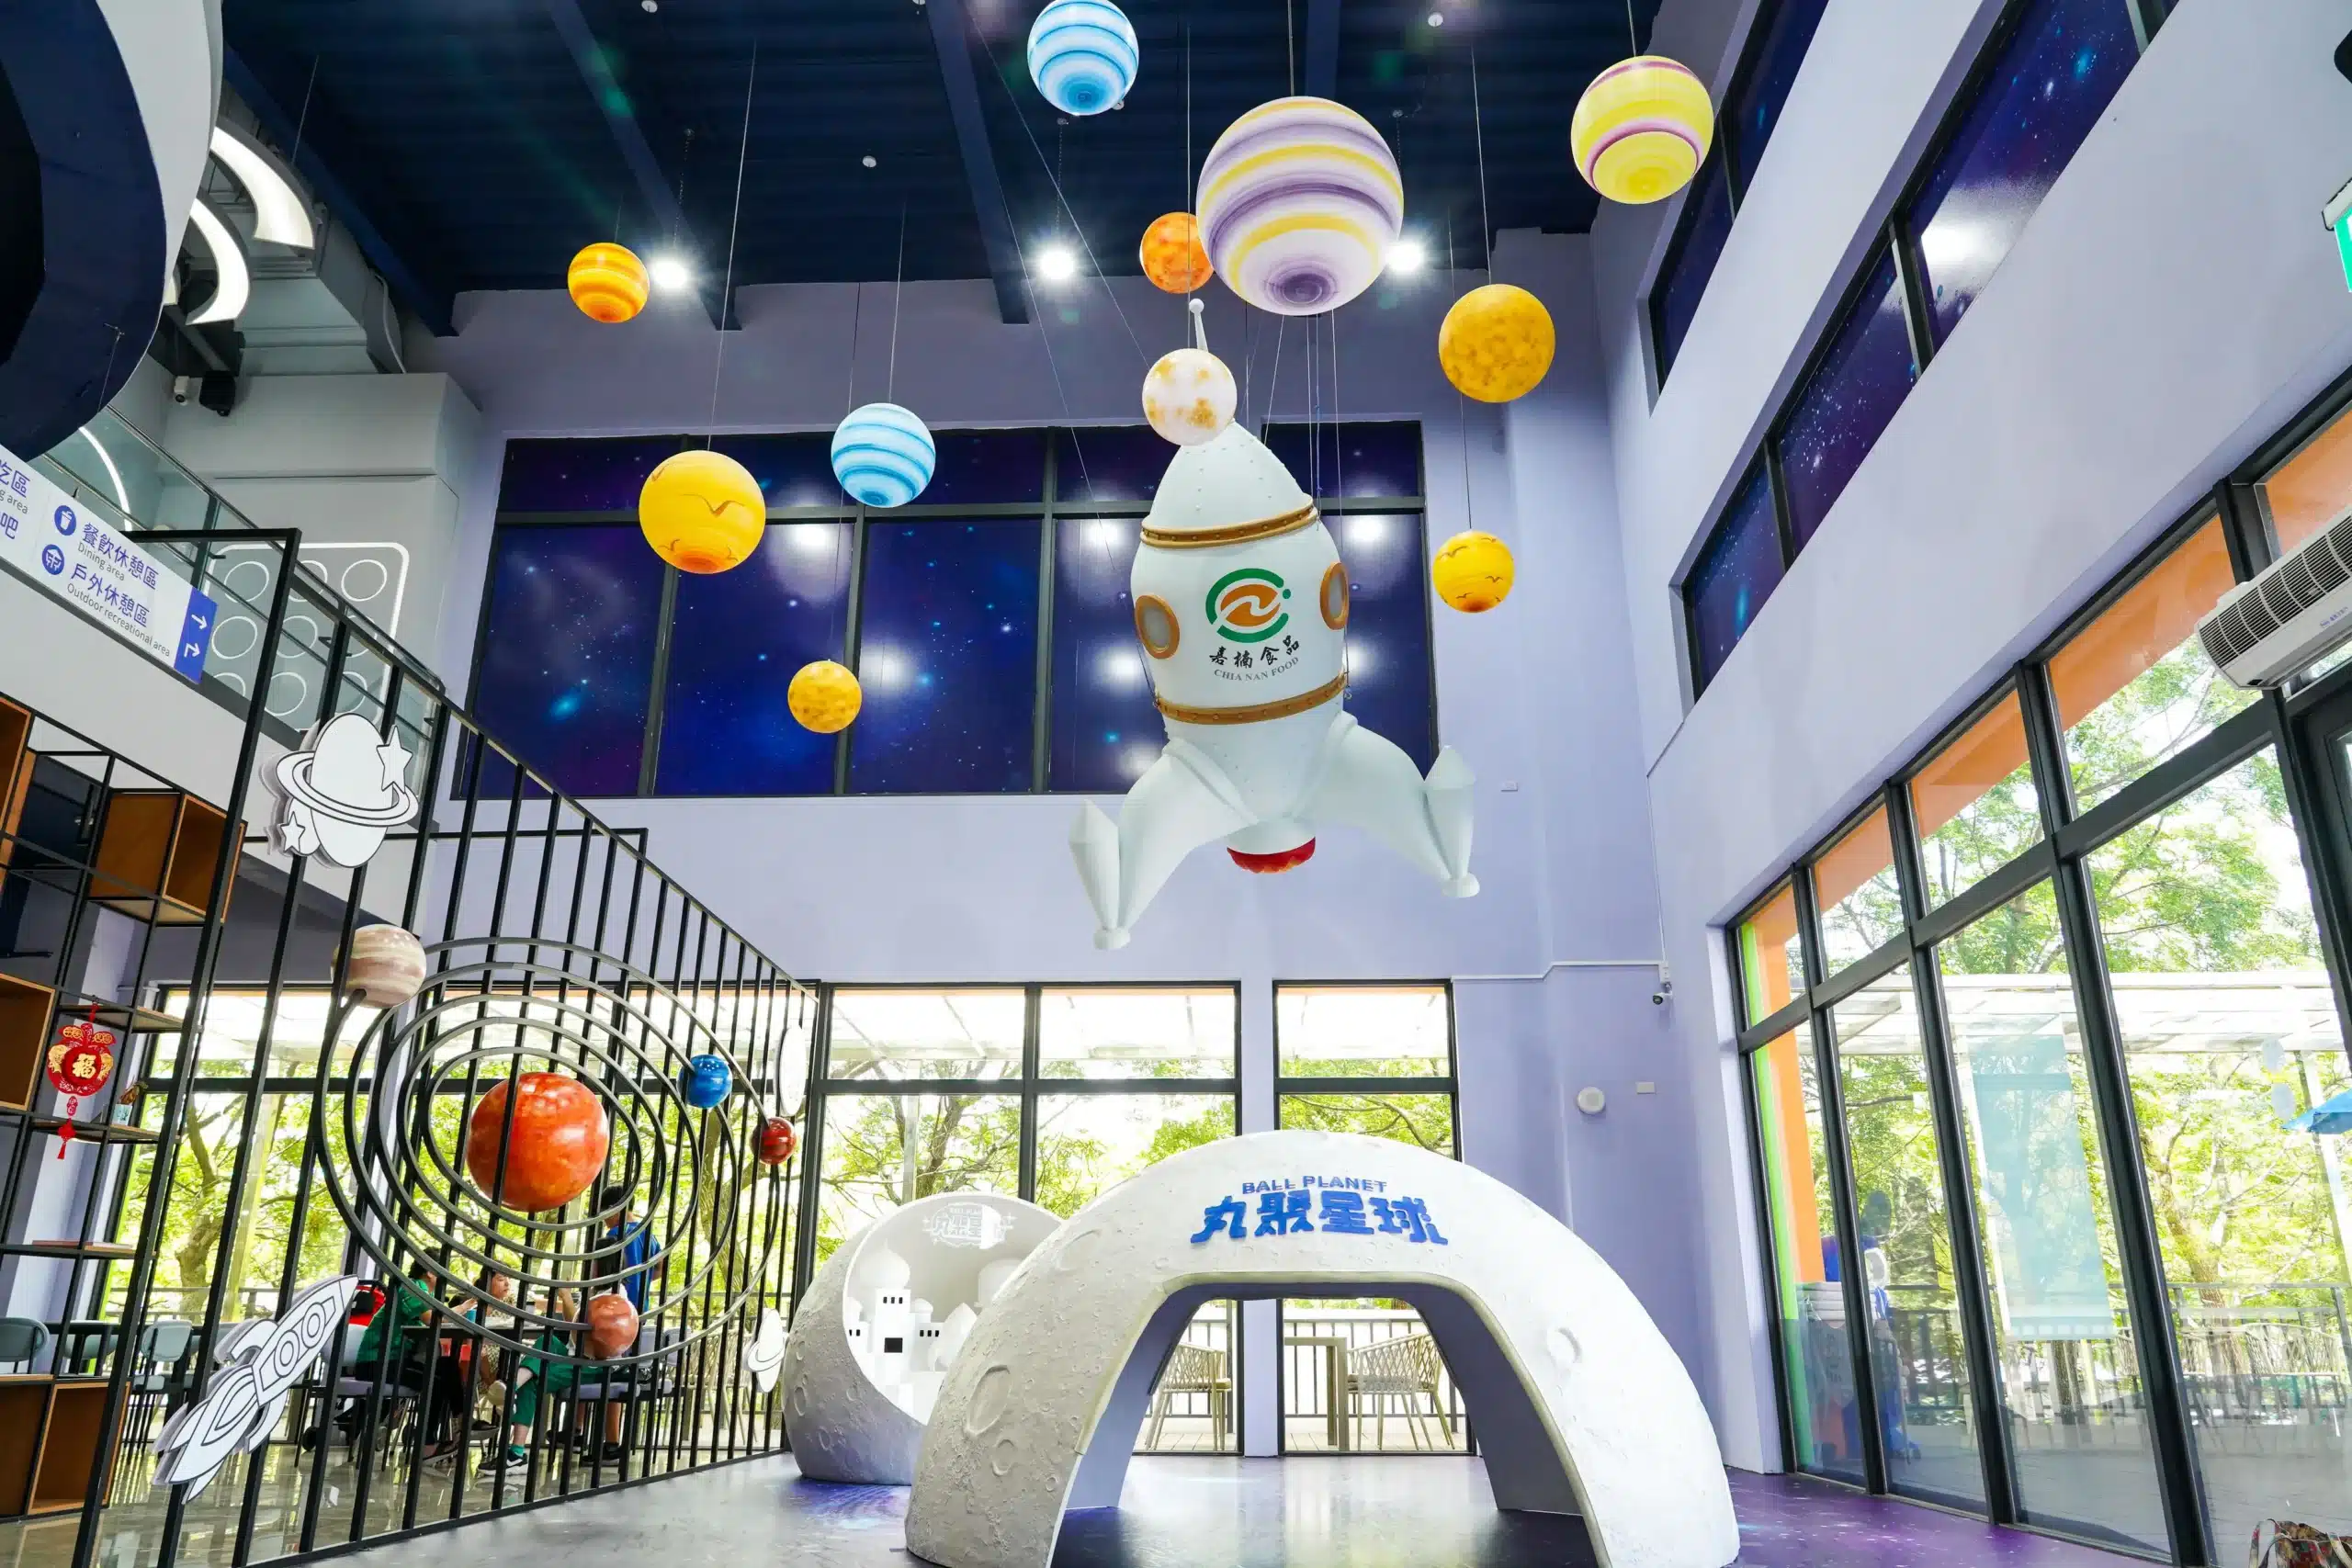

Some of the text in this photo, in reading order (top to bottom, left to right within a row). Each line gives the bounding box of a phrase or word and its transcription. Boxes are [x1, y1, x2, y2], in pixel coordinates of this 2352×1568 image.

[6, 495, 28, 514] area
[78, 542, 125, 581] Dining area
[83, 523, 159, 590] 餐飲休憩區
[67, 582, 171, 657] Outdoor recreational area
[1214, 657, 1299, 681] CHIA NAN FOOD
[73, 1053, 96, 1079] 福
[1242, 1175, 1387, 1194] BALL PLANET
